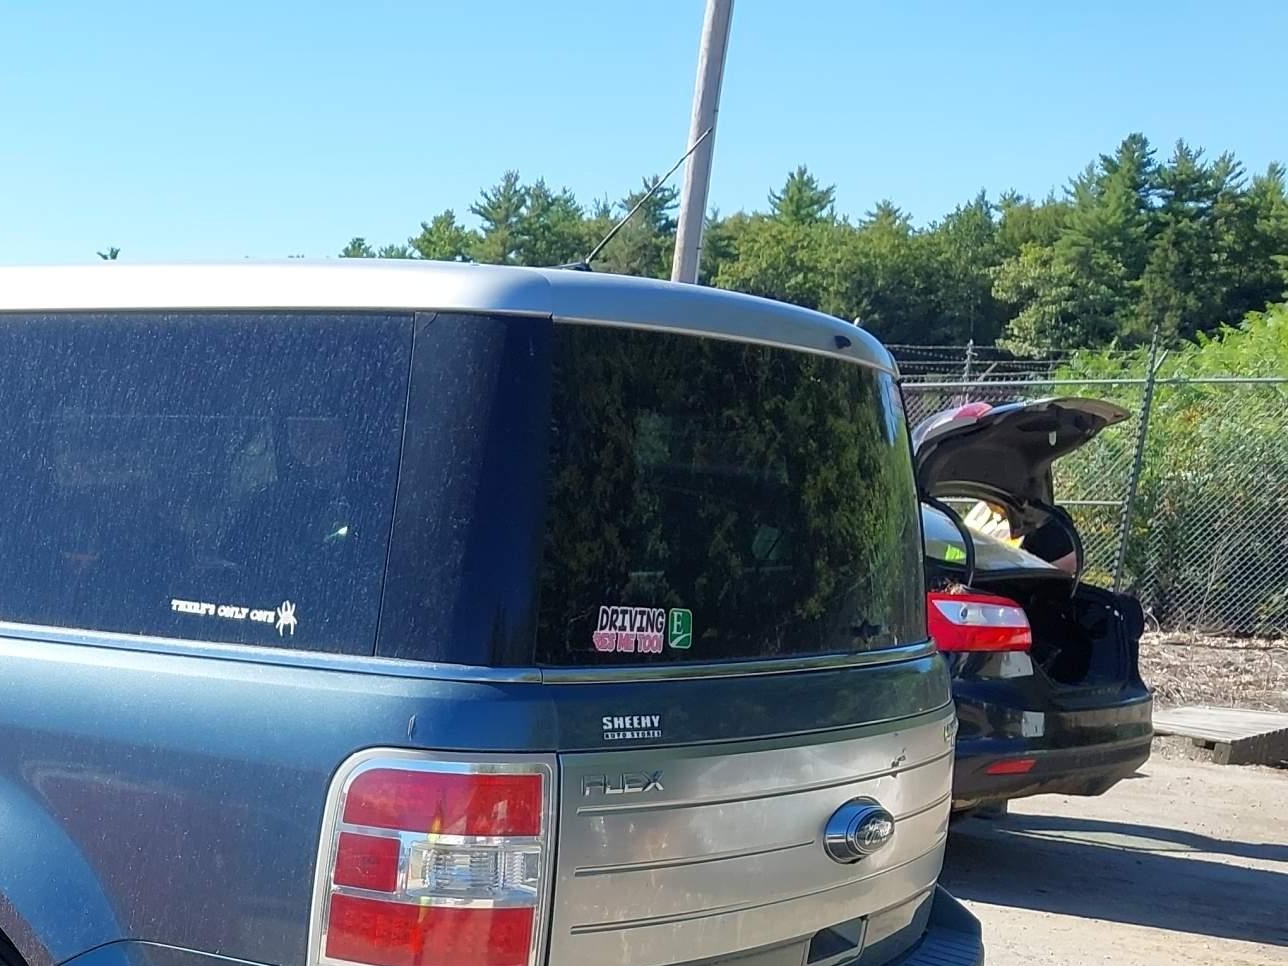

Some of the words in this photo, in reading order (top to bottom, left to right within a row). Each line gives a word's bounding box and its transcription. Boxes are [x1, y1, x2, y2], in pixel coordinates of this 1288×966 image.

[218, 605, 249, 619] ONLY
[250, 609, 275, 623] ONE
[598, 606, 665, 634] DRIVING
[672, 611, 683, 635] E
[602, 715, 660, 730] SHEEHY
[581, 769, 665, 796] FLEX
